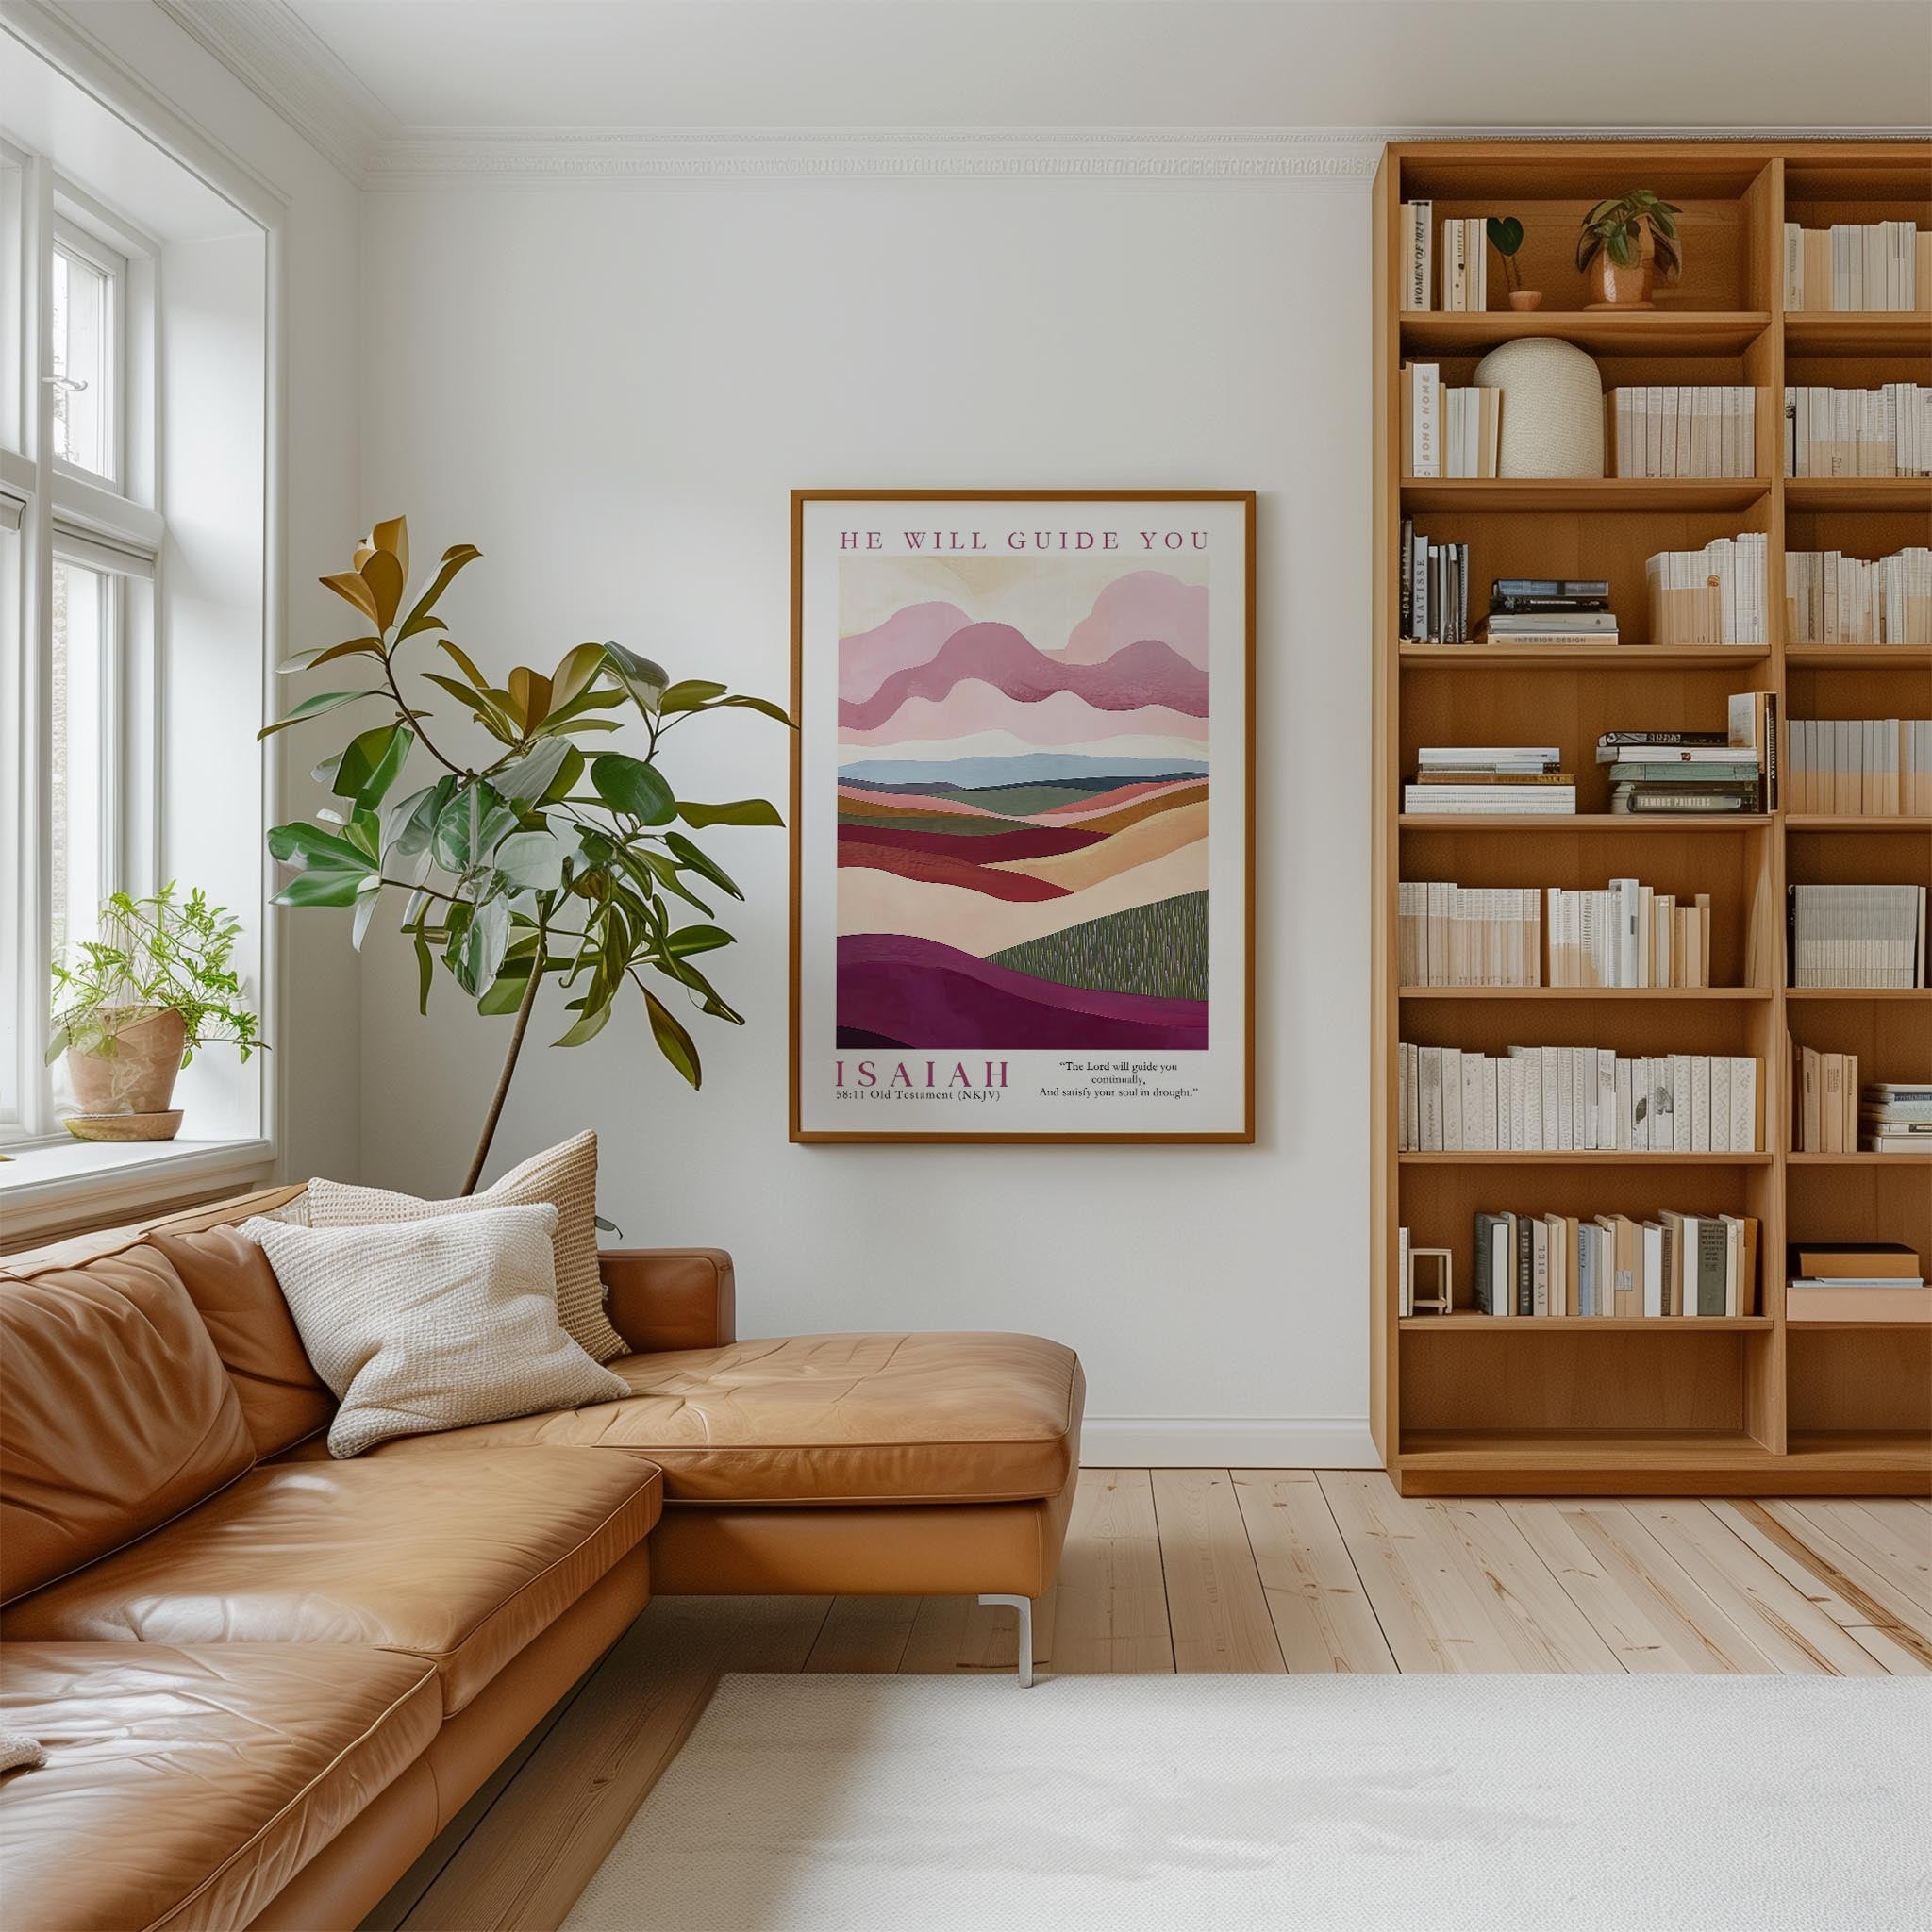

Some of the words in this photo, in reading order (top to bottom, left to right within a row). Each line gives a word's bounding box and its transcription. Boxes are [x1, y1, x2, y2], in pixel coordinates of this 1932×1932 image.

[1415, 221, 1424, 242] 2024
[1415, 245, 1424, 260] OF
[1414, 263, 1424, 305] WOMEN
[1422, 375, 1430, 415] HOME
[1422, 422, 1430, 461] BOHO
[840, 531, 884, 550] HE
[903, 531, 987, 550] WILL
[1008, 531, 1120, 550] GUIDE
[1140, 531, 1208, 550] YOU
[1416, 559, 1425, 625] MATISSE
[1640, 797, 1671, 807] FAMOUS
[1674, 797, 1710, 807] PAINTERS
[835, 1060, 1008, 1087] ISAIAH
[1086, 1061, 1110, 1072] Lord
[1112, 1061, 1130, 1072] will
[1132, 1061, 1158, 1074] guide
[1160, 1064, 1178, 1074] you
[1091, 1074, 1146, 1086] continually,
[835, 1091, 865, 1100] 58:11
[870, 1090, 891, 1100] Old
[894, 1090, 954, 1100] Testament
[958, 1090, 1001, 1102] (NKJV)
[1039, 1087, 1059, 1097] And
[1062, 1087, 1091, 1099] satisfy
[1094, 1090, 1115, 1099] your
[1118, 1087, 1138, 1097] soul
[1141, 1088, 1150, 1097] in
[1538, 1245, 1546, 1274] BIEL
